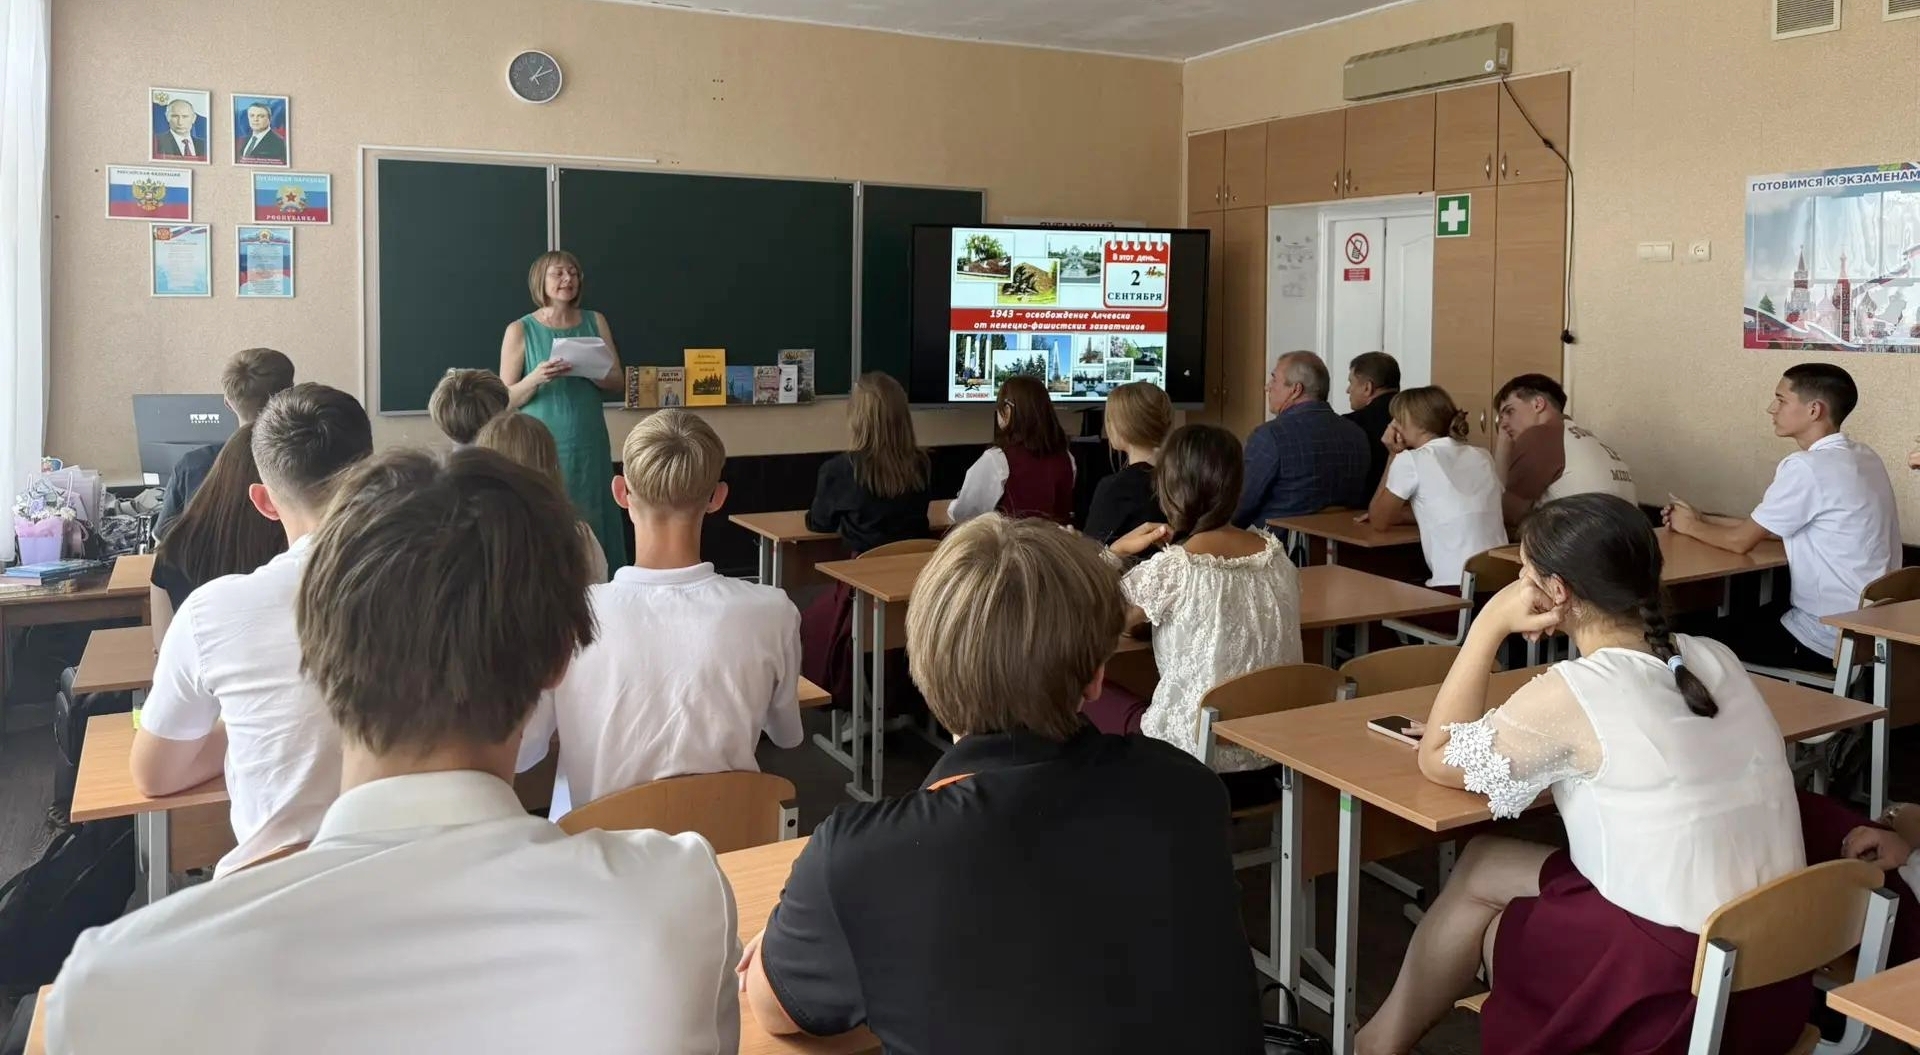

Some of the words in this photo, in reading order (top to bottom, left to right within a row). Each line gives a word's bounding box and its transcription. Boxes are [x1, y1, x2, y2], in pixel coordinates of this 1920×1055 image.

[1752, 178, 1823, 192] ГОТОВИМСЯ
[1827, 177, 1834, 186] К
[1839, 170, 1920, 184] ЭКЗАМЕНАМ
[1112, 253, 1118, 261] В
[1130, 270, 1140, 286] 2
[1107, 292, 1162, 301] СЕНТЯБРЯ
[990, 309, 1014, 318] 1943
[1025, 311, 1089, 320] освобождение
[1091, 311, 1131, 320] Алчевска
[990, 321, 1086, 331] немецко-фашистских
[1089, 323, 1146, 331] захватчиков
